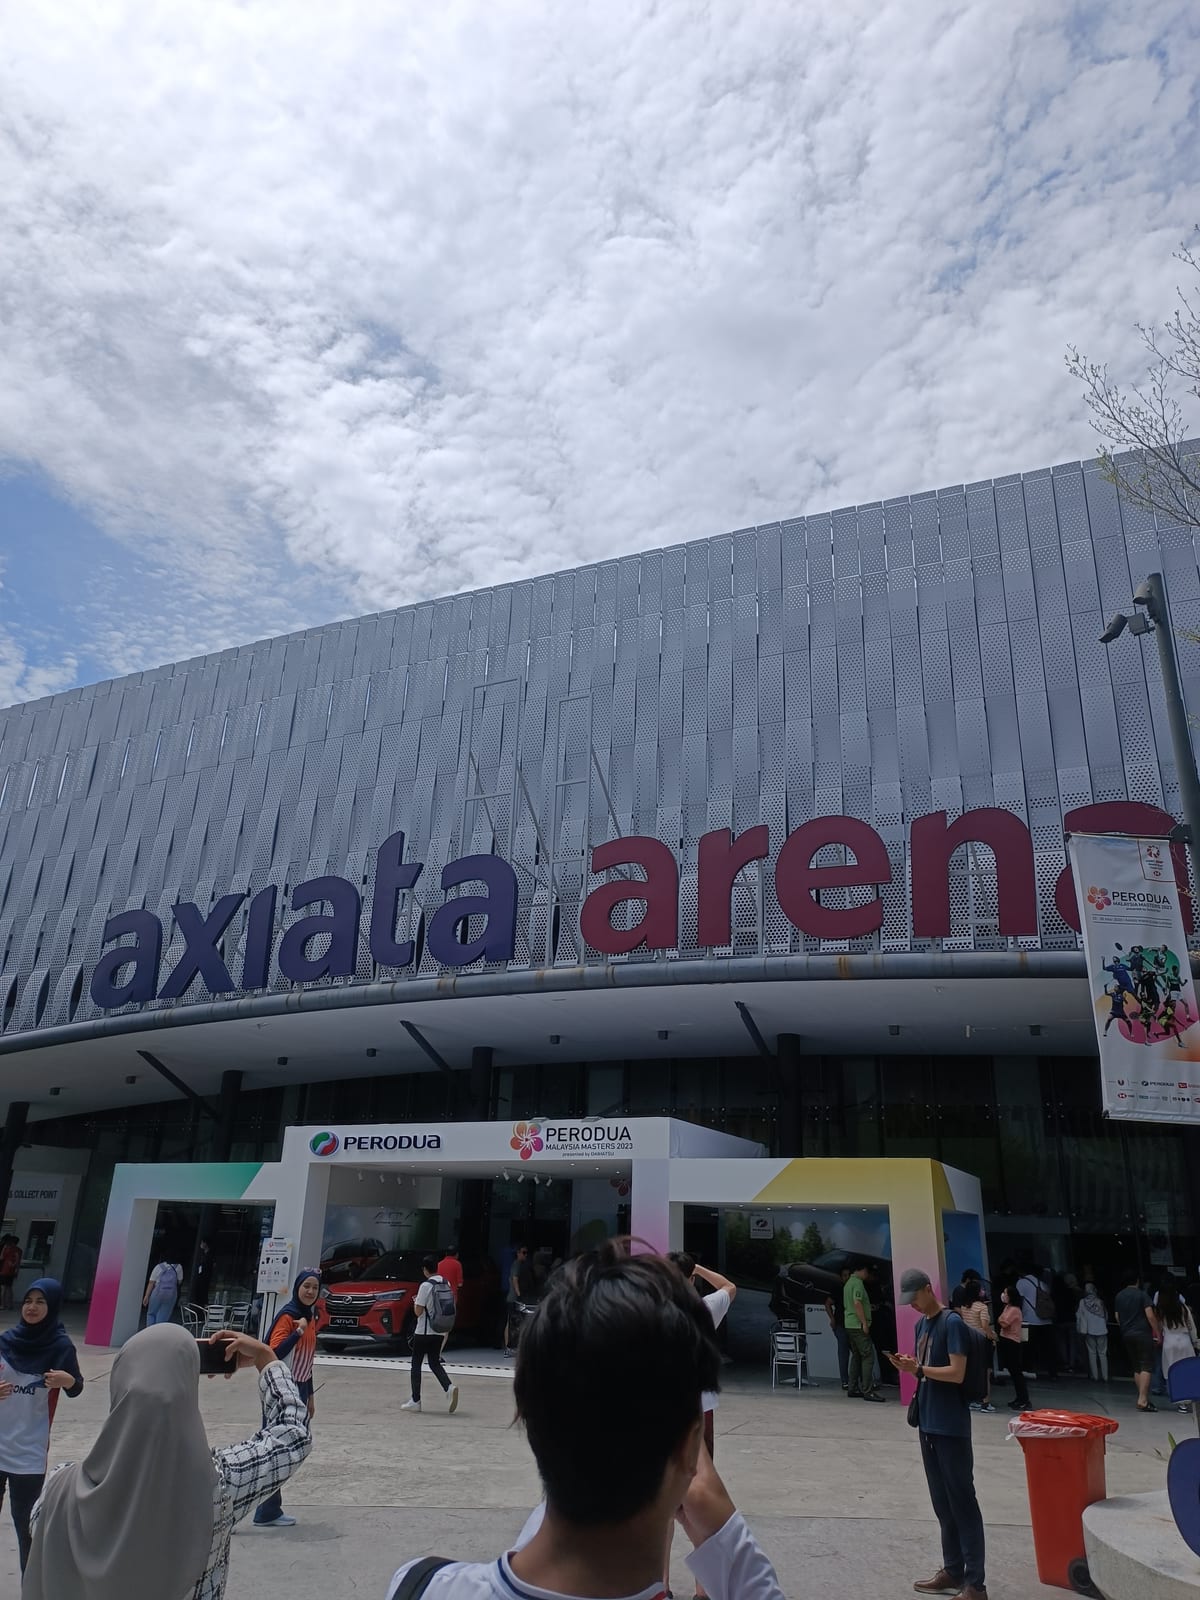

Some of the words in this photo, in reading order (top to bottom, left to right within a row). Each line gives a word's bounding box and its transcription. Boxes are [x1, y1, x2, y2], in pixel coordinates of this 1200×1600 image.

[1112, 891, 1170, 905] PERODUA
[91, 831, 519, 1009] axiata
[546, 1127, 631, 1142] PERODUA
[545, 1142, 580, 1151] MALAYSIA
[581, 1142, 616, 1150] MASTERS
[616, 1142, 633, 1150] 2023
[15, 1190, 39, 1198] COLLECT
[40, 1190, 58, 1198] POINT
